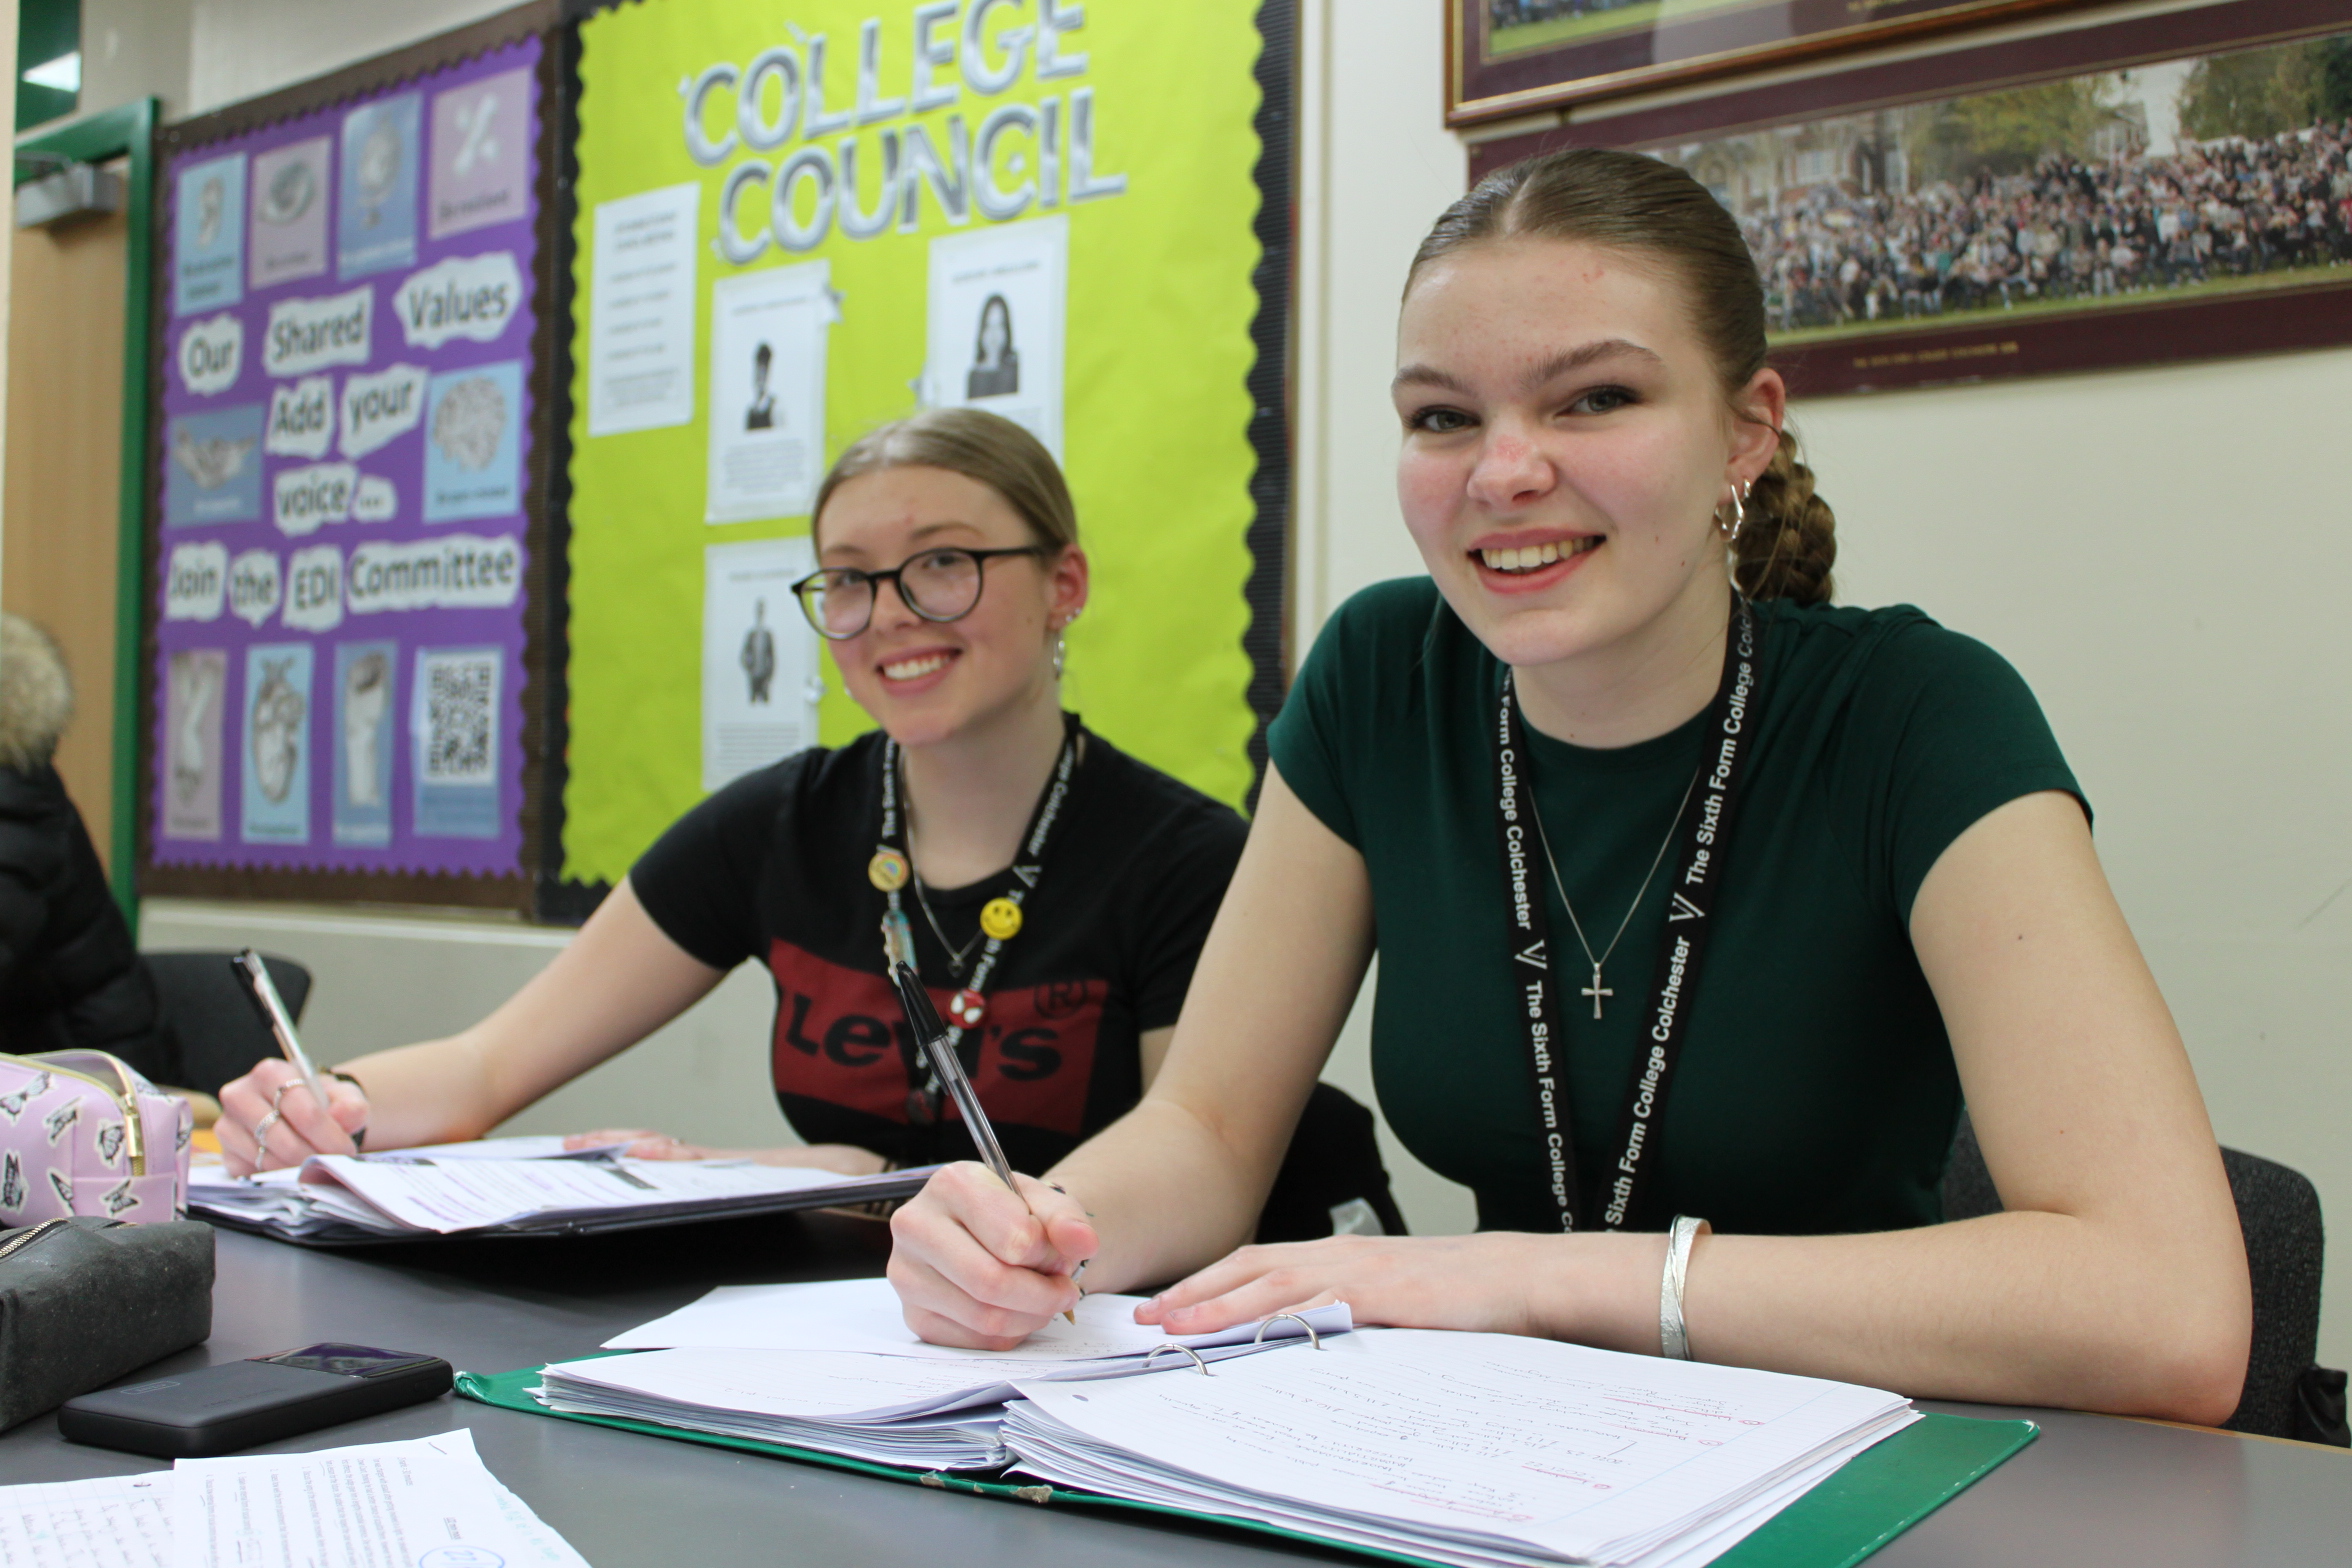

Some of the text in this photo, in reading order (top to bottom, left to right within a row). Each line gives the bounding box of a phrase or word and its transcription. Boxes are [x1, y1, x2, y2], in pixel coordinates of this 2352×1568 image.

[683, 0, 1090, 167] COLLEGE
[717, 86, 1128, 266] COUNCIL
[187, 279, 510, 378] Our Shared Values
[274, 383, 414, 434] Add your
[278, 474, 349, 518] voice
[170, 545, 515, 612] Join the EDI Committee
[1723, 660, 1755, 735] College
[1499, 748, 1518, 822] College
[1708, 737, 1738, 791] Form
[1696, 794, 1724, 847] Sixth
[1506, 824, 1532, 931] Colchester
[1685, 848, 1711, 886] The
[1526, 979, 1544, 1019] The
[1531, 1021, 1552, 1074] Sixth
[1604, 935, 1691, 1226] Sixth Form College Colchester
[1538, 1077, 1558, 1129] Form
[1547, 1132, 1568, 1208] College
